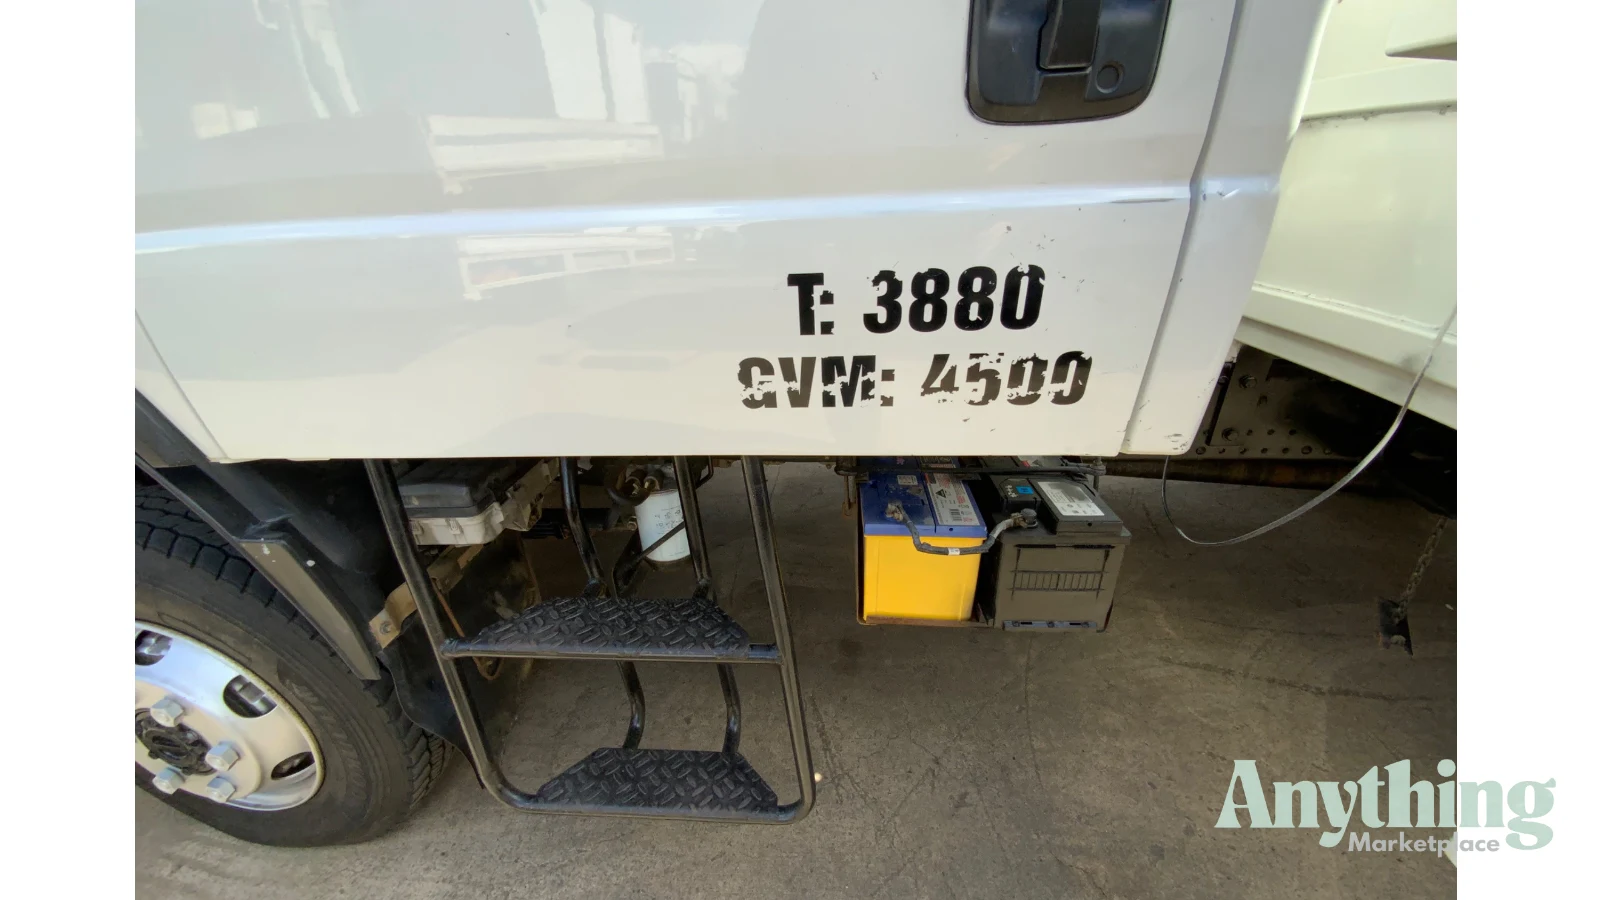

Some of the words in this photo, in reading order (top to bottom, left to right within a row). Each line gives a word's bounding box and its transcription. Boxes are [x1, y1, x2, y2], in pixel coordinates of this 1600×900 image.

[787, 272, 835, 335] T:
[863, 264, 1046, 334] 3880
[737, 354, 895, 409] GVM:
[920, 350, 1093, 406] 4500
